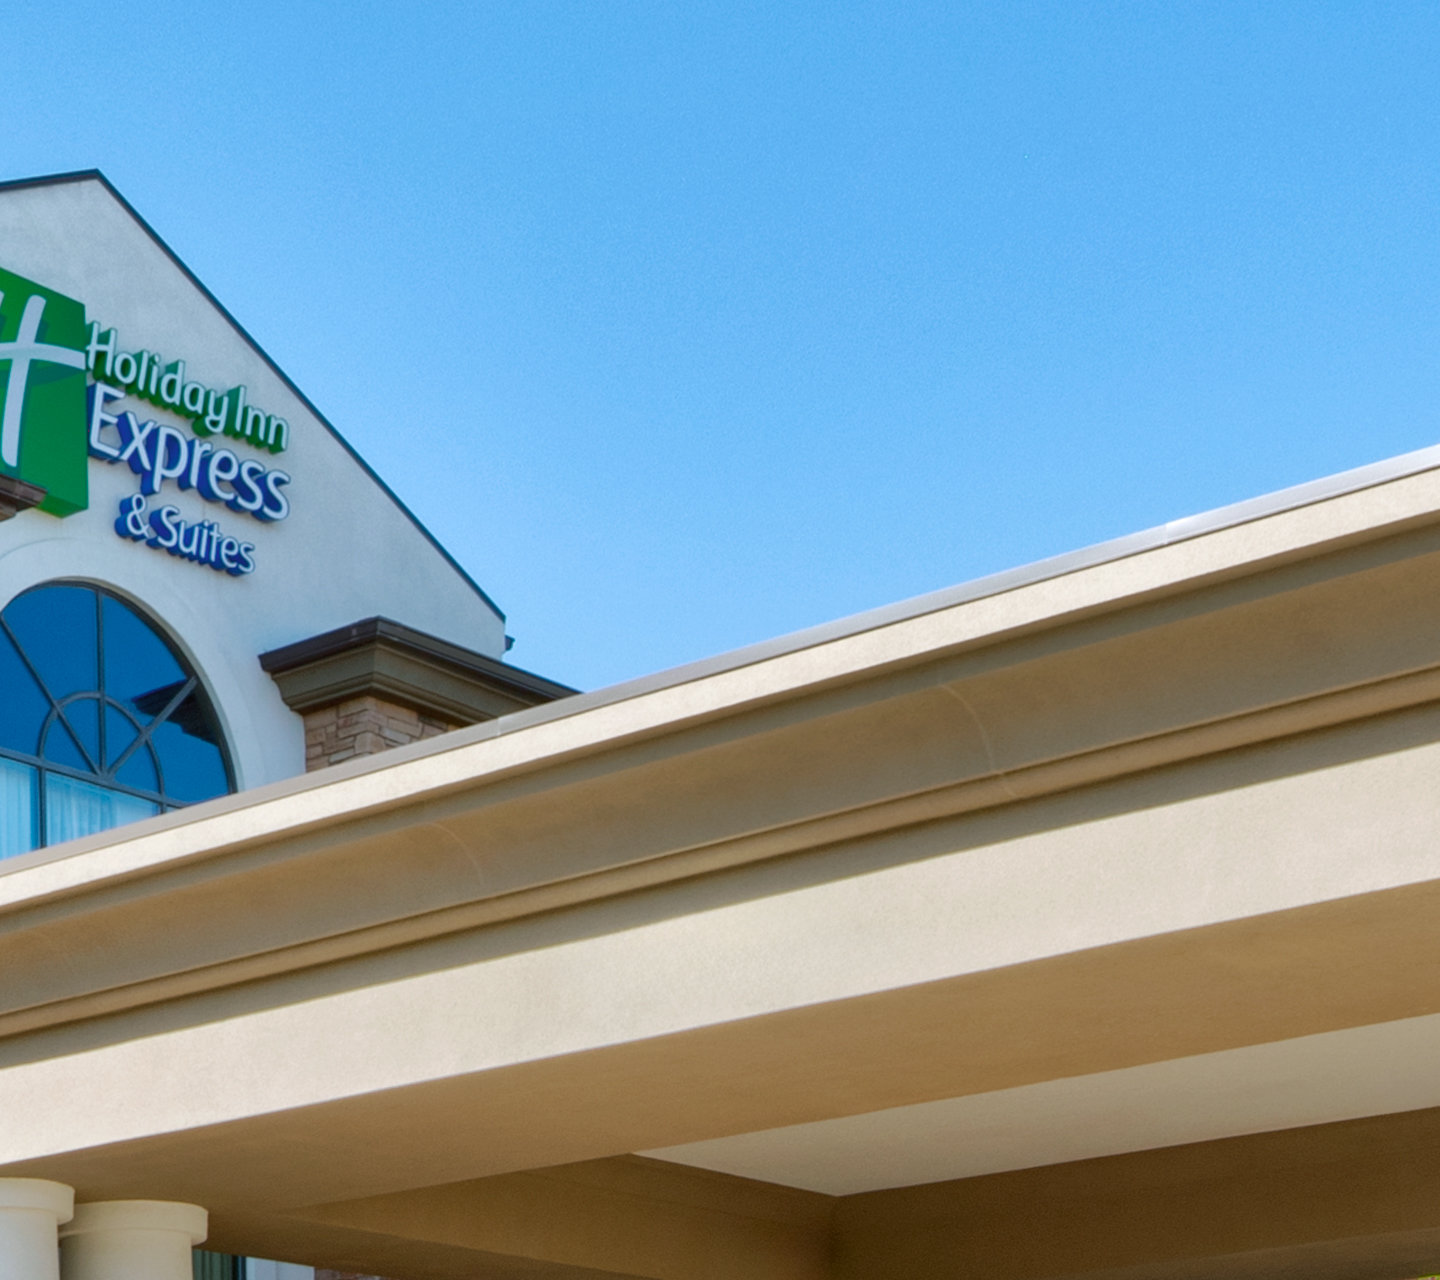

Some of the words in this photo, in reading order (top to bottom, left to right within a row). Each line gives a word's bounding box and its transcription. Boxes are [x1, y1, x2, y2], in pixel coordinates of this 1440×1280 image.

[85, 321, 229, 434] Holiday
[234, 385, 289, 451] Inn
[88, 382, 292, 521] Express
[123, 493, 151, 539] &
[156, 505, 256, 573] Suites
